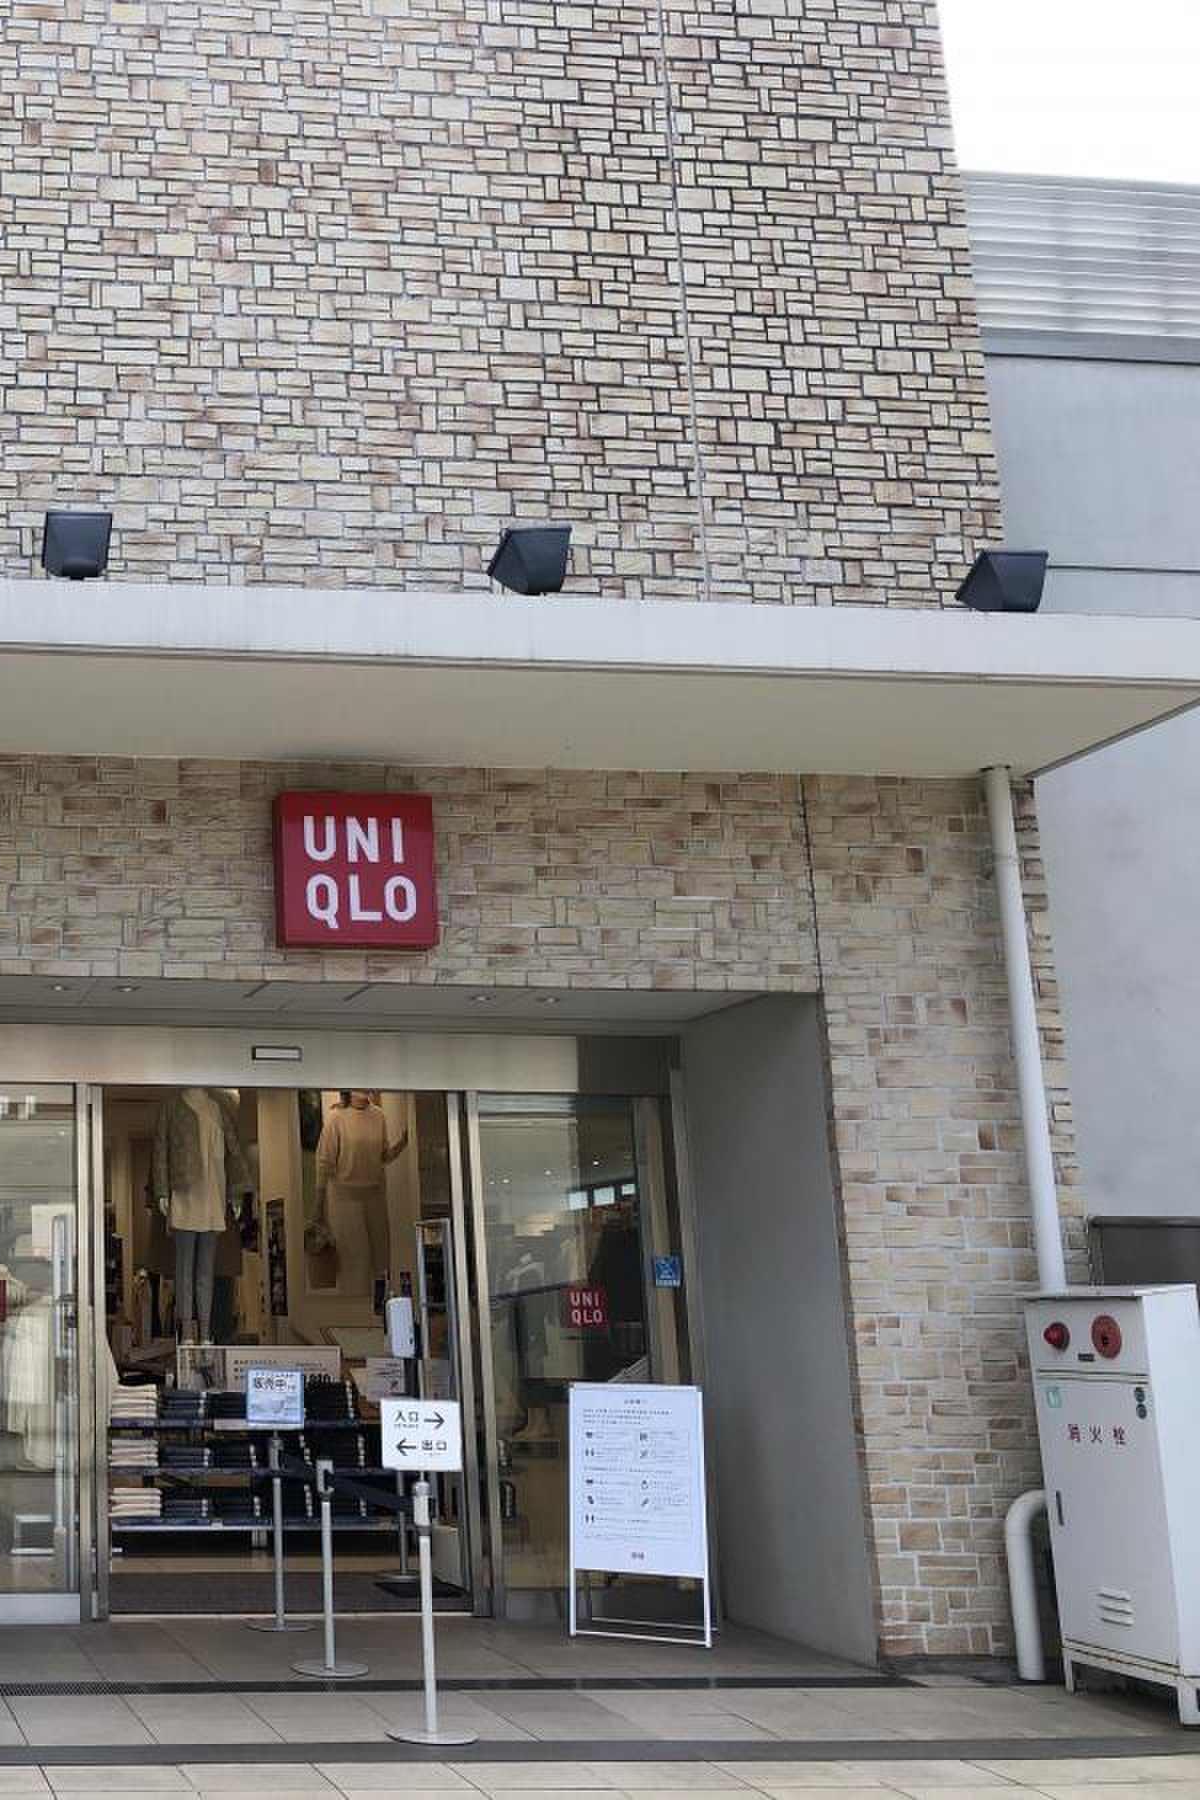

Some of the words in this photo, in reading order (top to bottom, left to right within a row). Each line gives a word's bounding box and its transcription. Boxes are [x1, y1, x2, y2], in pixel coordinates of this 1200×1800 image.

[303, 815, 405, 864] UNI
[306, 873, 418, 929] QLO
[569, 1291, 601, 1307] UNI
[570, 1309, 604, 1326] QLO
[394, 1409, 419, 1423] 入口
[1067, 1423, 1127, 1445] 消火栓
[421, 1439, 448, 1452] 出口
